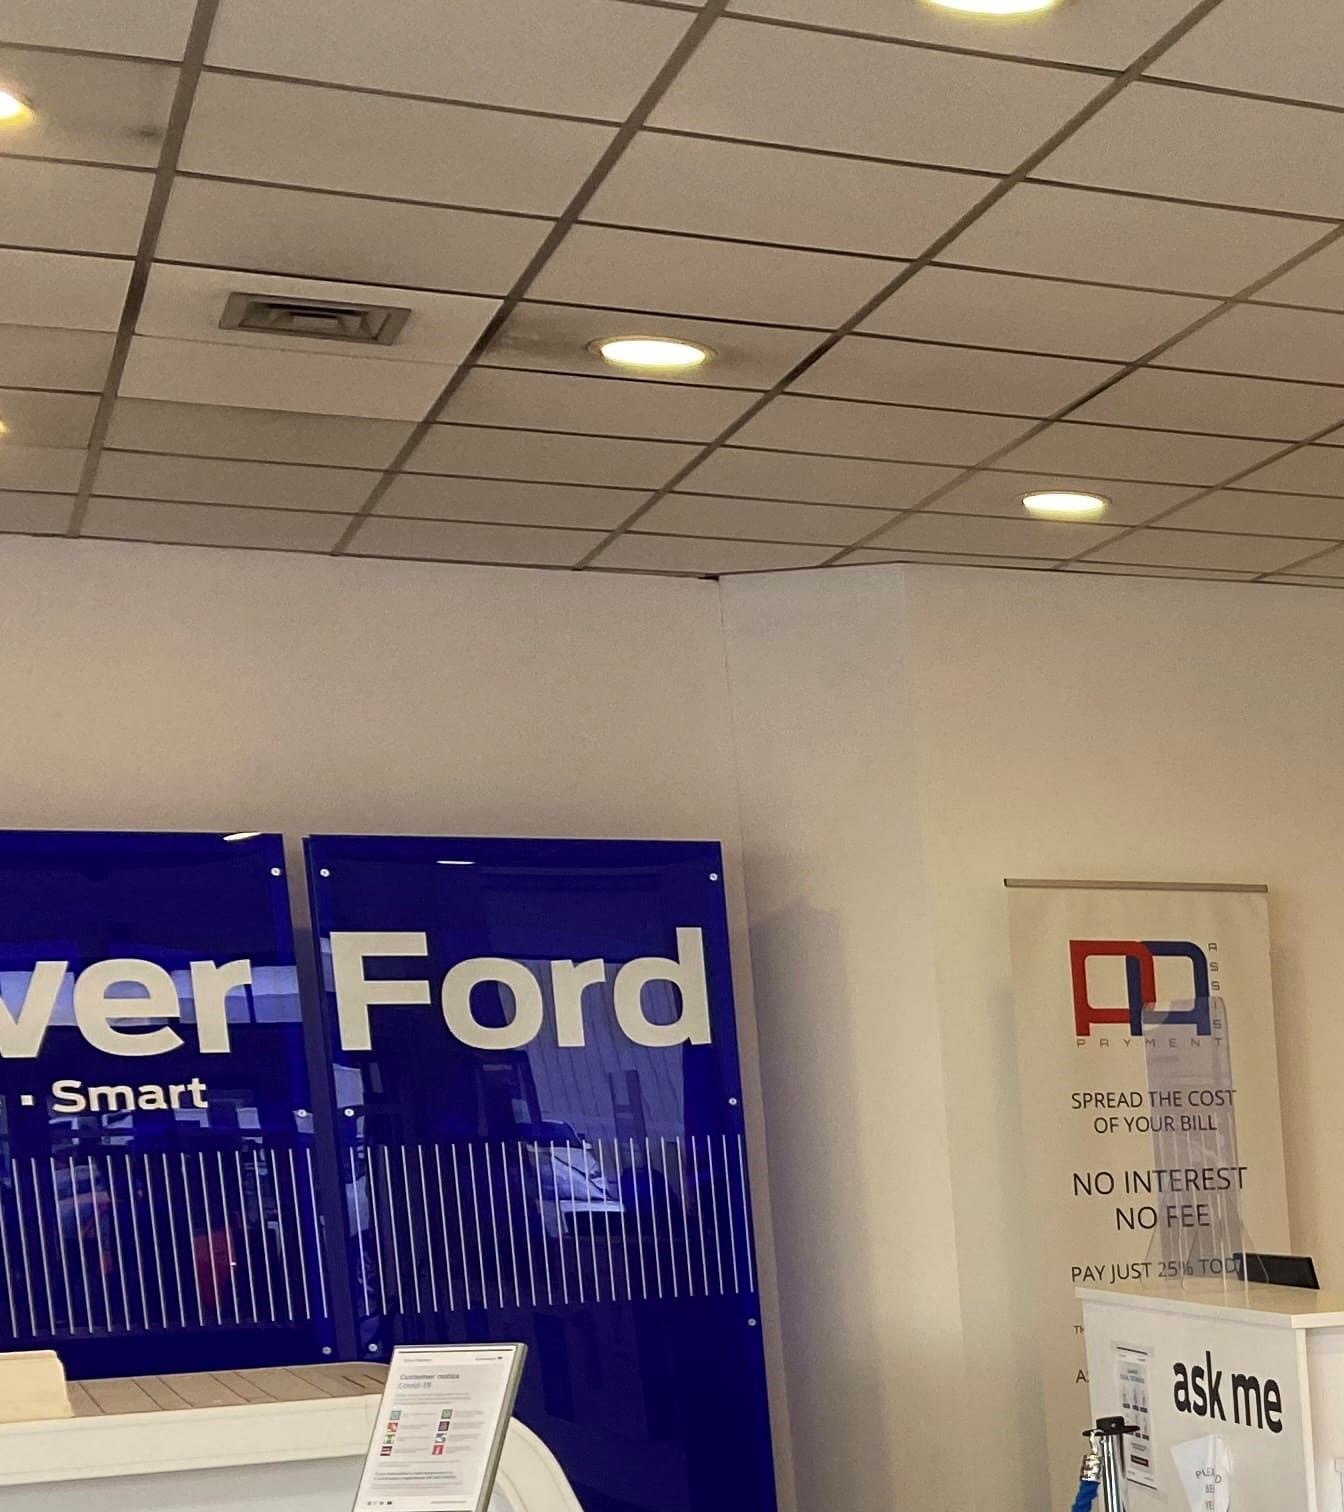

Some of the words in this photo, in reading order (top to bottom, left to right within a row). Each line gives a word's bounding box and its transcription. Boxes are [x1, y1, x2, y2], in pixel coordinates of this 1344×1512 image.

[329, 927, 712, 1051] Ford
[1077, 1037, 1223, 1048] PAYMENT
[52, 1078, 208, 1113] Smart
[1071, 1092, 1142, 1109] SPREAD
[1149, 1091, 1181, 1107] THE
[1188, 1090, 1237, 1105] COST
[1094, 1117, 1118, 1134] OF
[1124, 1116, 1175, 1132] YOUR
[1181, 1114, 1217, 1131] BILL
[1073, 1171, 1114, 1196] NO
[1124, 1167, 1248, 1193] INTEREST
[1116, 1205, 1157, 1230] NO
[1167, 1204, 1210, 1226] FEE
[1072, 1265, 1105, 1282] PAY
[1110, 1263, 1151, 1284] JUST
[1173, 1351, 1226, 1422] ask
[1231, 1372, 1282, 1433] me
